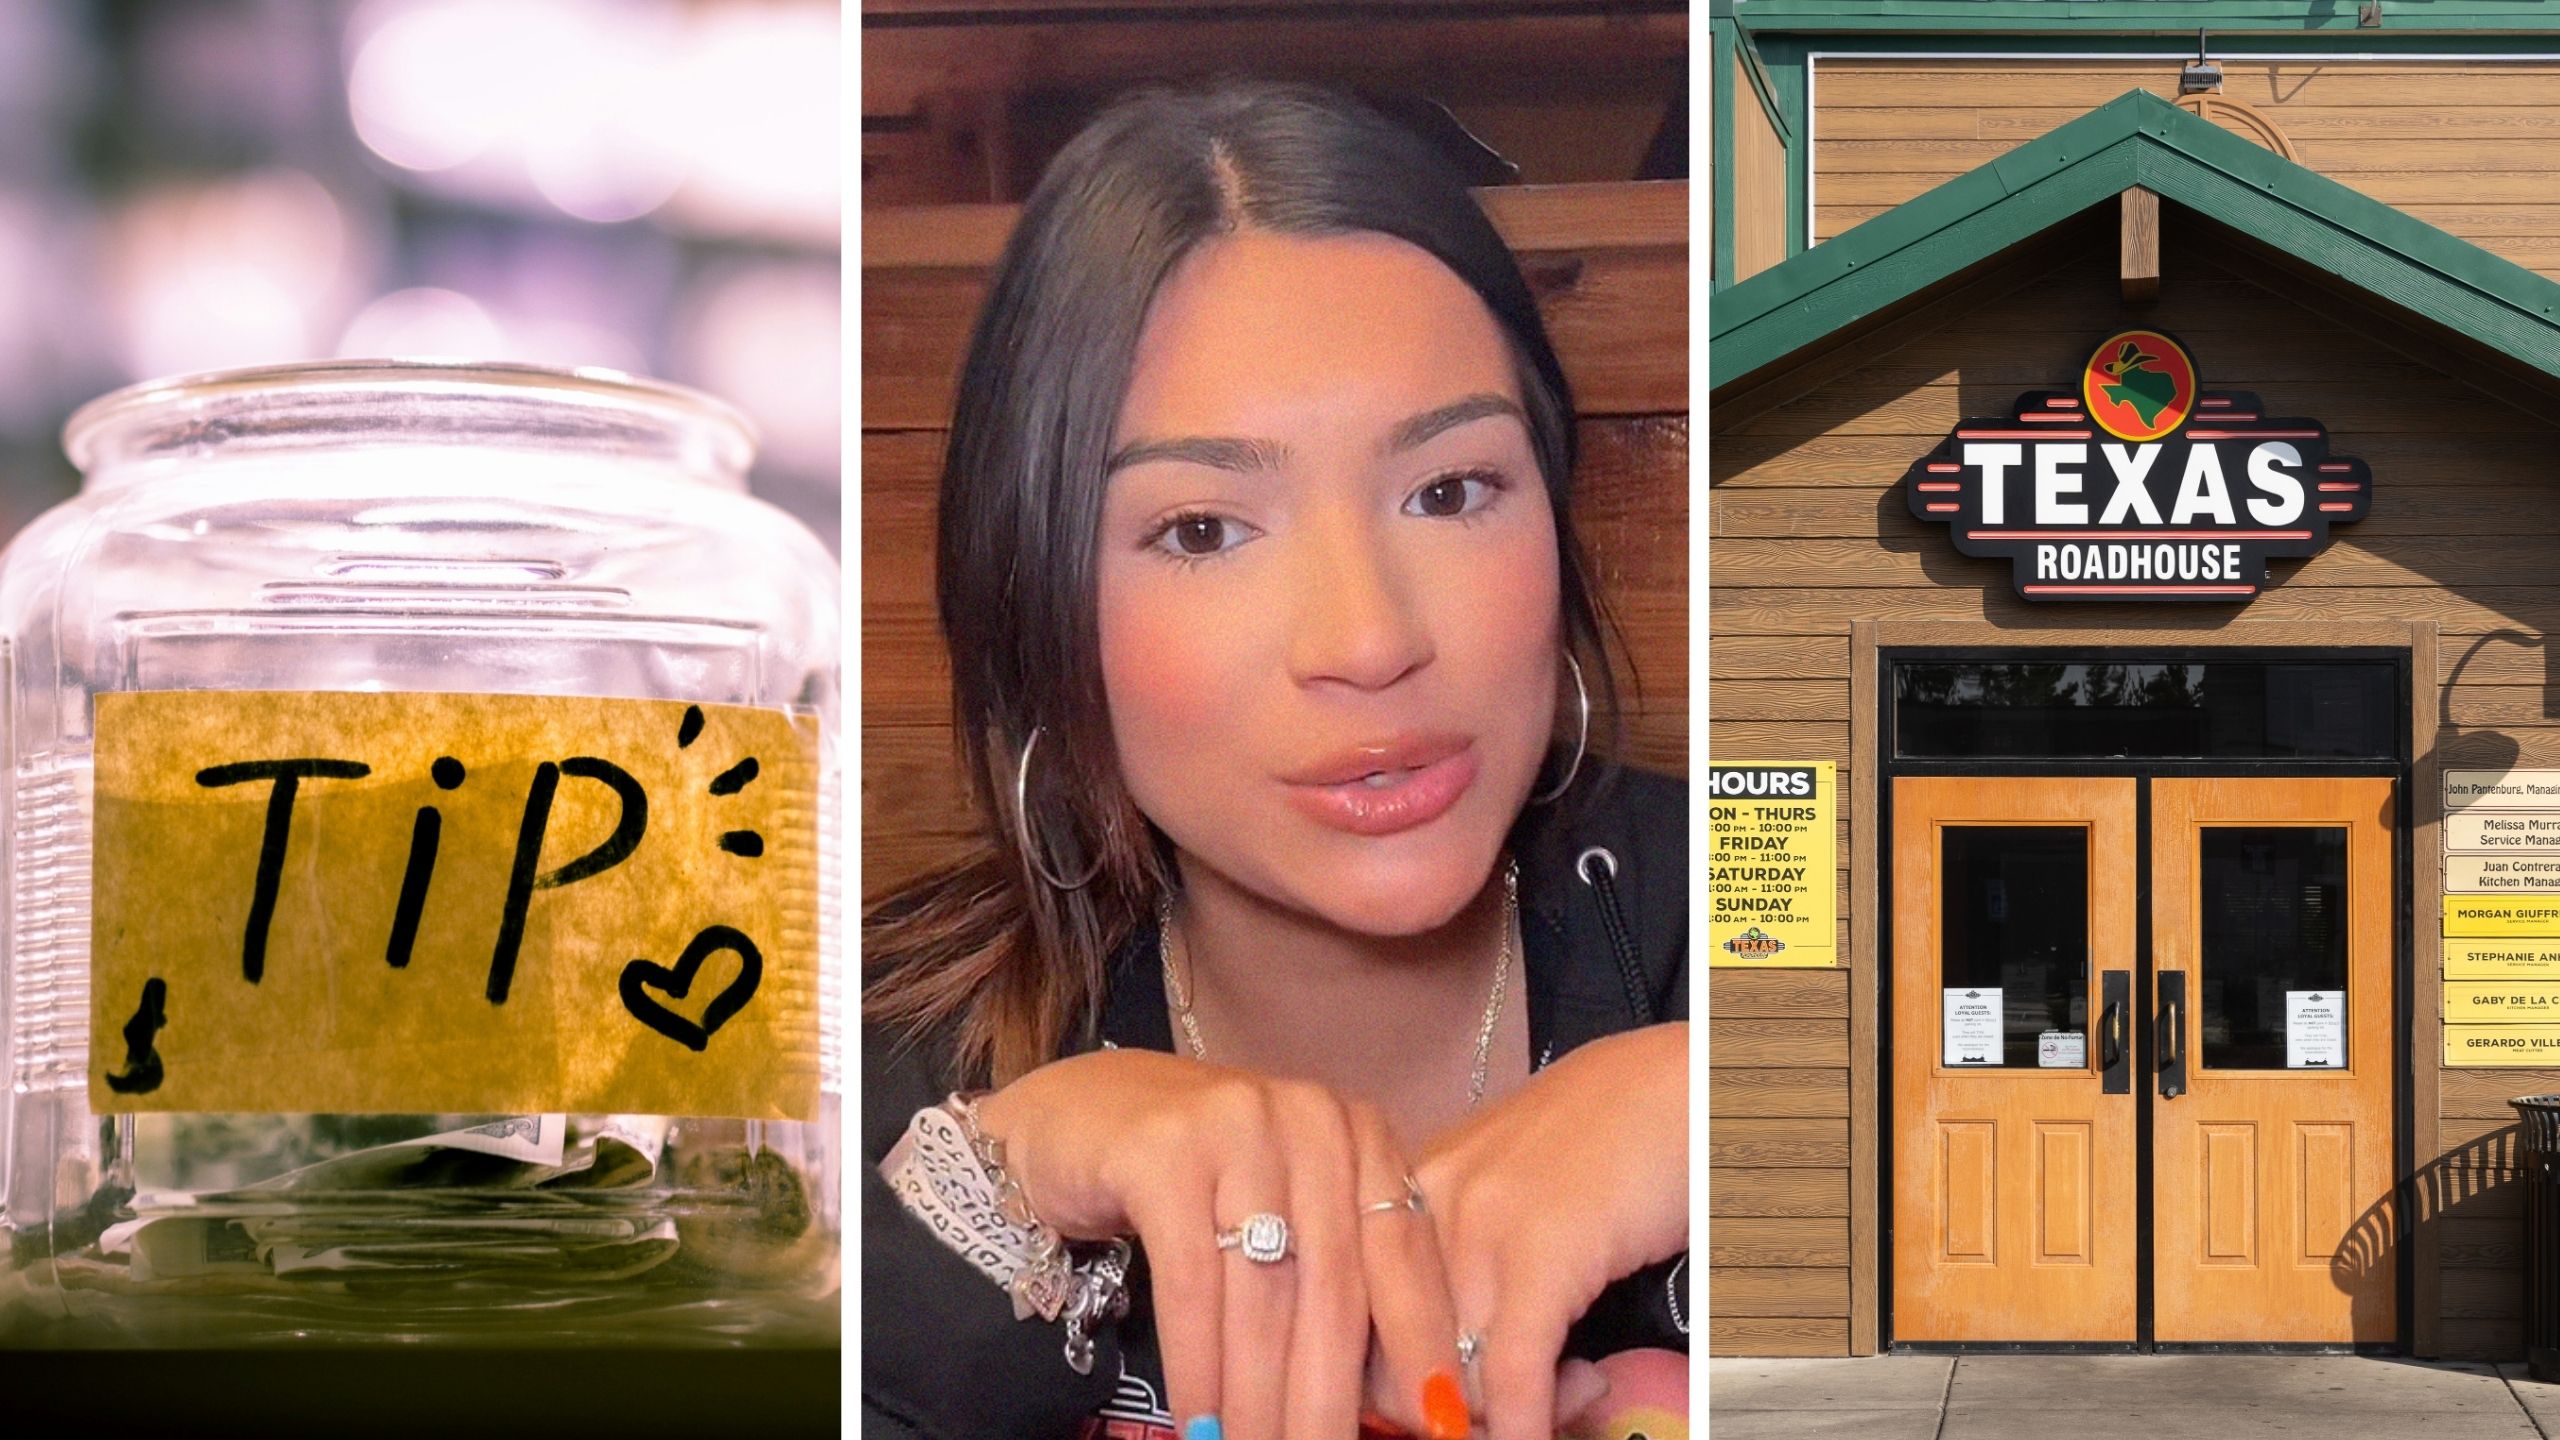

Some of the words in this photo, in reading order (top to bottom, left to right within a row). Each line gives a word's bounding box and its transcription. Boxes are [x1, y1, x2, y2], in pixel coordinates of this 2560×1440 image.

[1963, 440, 2306, 527] TEXAS
[2037, 544, 2241, 580] ROADHOUSE
[2448, 784, 2469, 795] John
[1754, 807, 1816, 820] THURS
[1759, 823, 1792, 832] 10:00
[2484, 819, 2525, 831] Melissa
[1720, 837, 1789, 850] FRIDAY
[2480, 834, 2522, 846] Service
[1760, 853, 1791, 862] 11:00
[2483, 861, 2509, 872] Juan
[2479, 876, 2520, 888] Kitchen
[1761, 884, 1792, 893] 11:00
[1716, 898, 1793, 911] SUNDAY
[1760, 914, 1794, 923] 10:00
[2458, 909, 2512, 919] MORGAN
[2516, 909, 2560, 919] GIUFFR
[1732, 940, 1777, 952] TEXAS
[2467, 952, 2535, 962] STEPHANIE
[2473, 996, 2506, 1005] GABY
[2510, 996, 2526, 1005] DE
[2530, 996, 2547, 1005] LA
[2466, 1038, 2526, 1048] GERARDO
